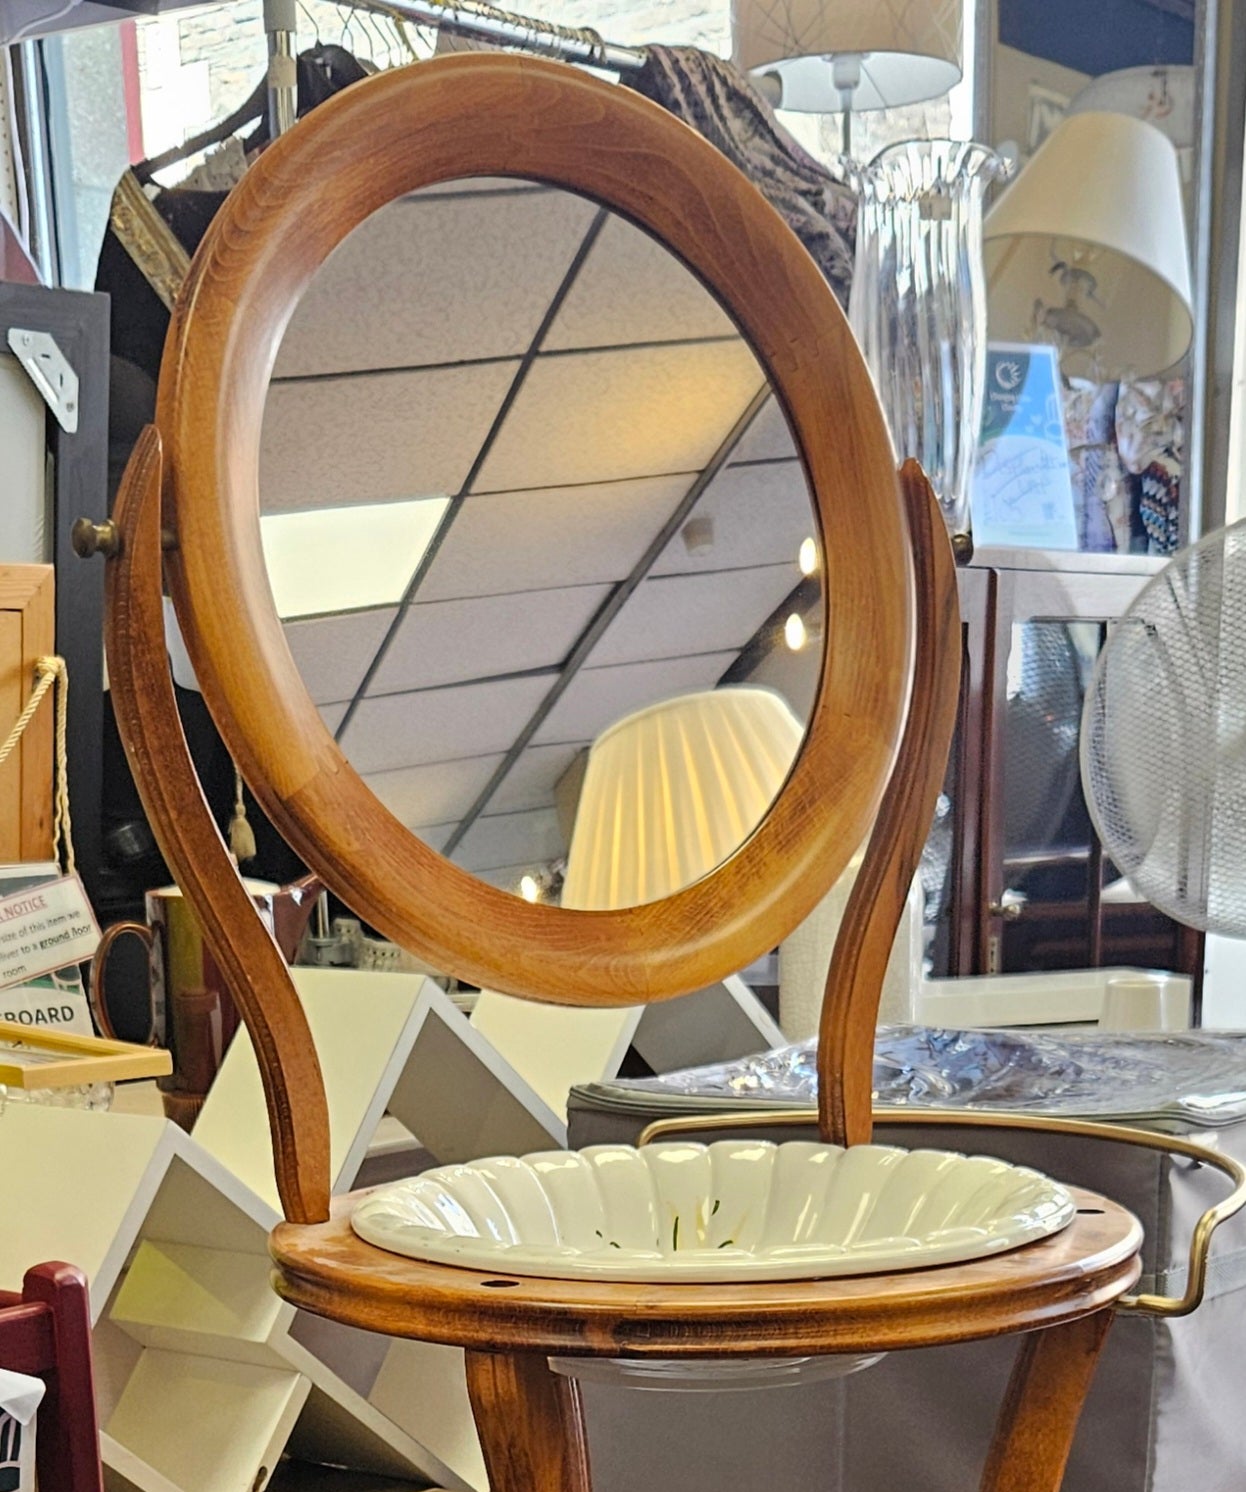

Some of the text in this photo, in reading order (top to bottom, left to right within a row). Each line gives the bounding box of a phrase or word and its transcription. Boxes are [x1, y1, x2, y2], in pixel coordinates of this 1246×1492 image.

[20, 944, 31, 955] to
[40, 930, 70, 951] ground
[71, 924, 91, 938] floor
[3, 965, 27, 978] room
[0, 1006, 74, 1025] BOARD
